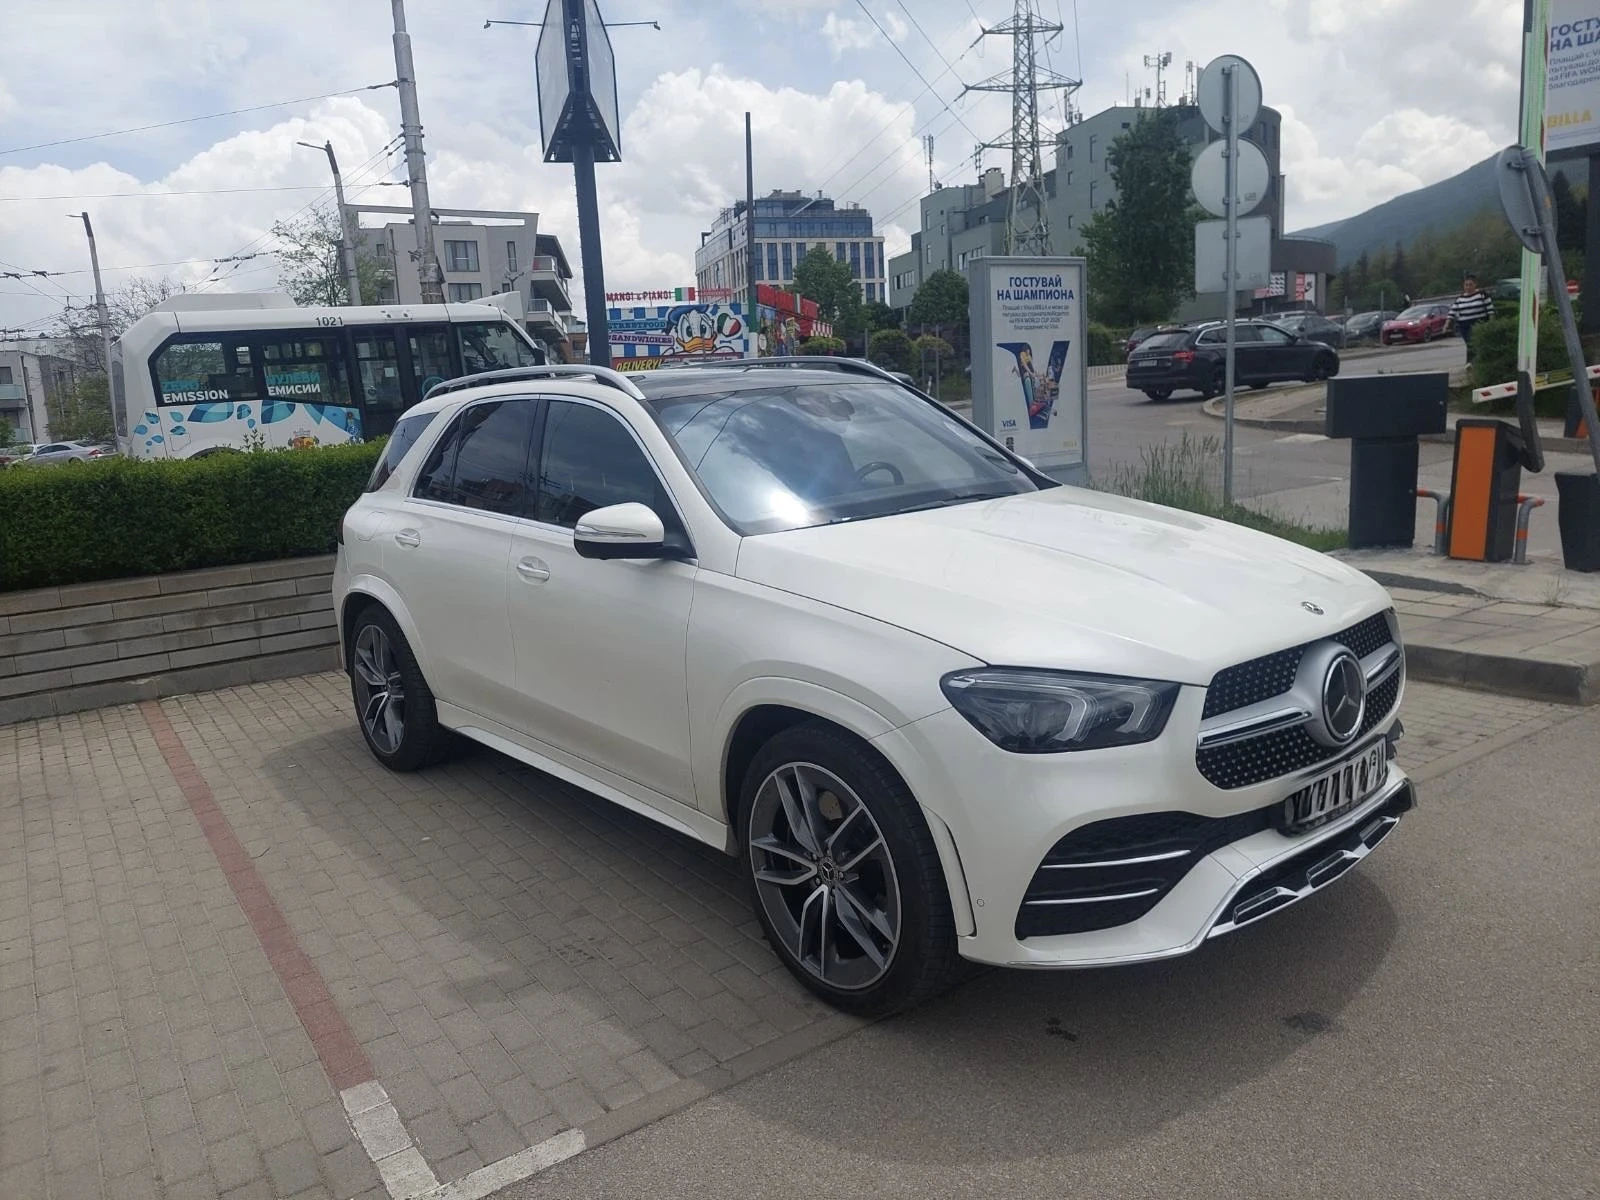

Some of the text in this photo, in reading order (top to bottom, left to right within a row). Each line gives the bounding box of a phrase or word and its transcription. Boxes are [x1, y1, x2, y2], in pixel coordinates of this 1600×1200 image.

[1550, 38, 1573, 52] НА
[1009, 274, 1062, 287] ГОСТУВАЙ
[997, 289, 1074, 300] НА ШАМПИОНА
[315, 316, 343, 327] 1021
[616, 359, 663, 373] DELIVERY!
[163, 390, 229, 403] EMISSION
[268, 384, 320, 396] ЕМИСИИ
